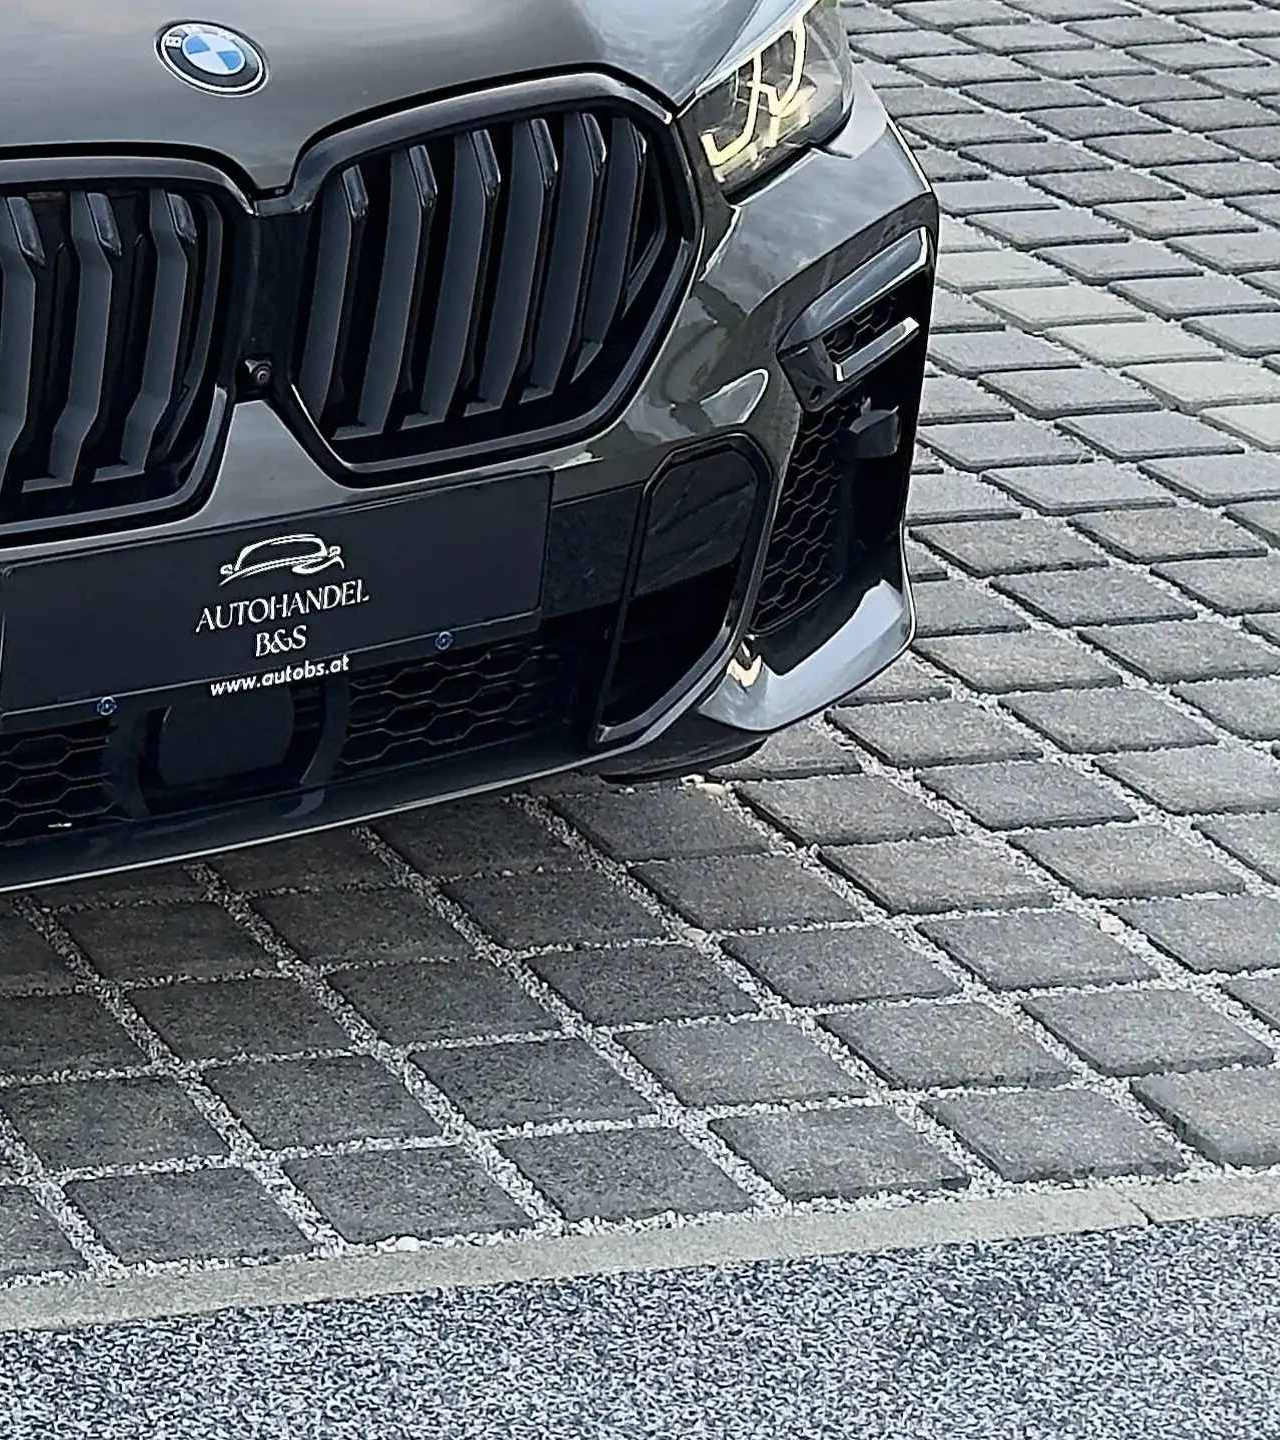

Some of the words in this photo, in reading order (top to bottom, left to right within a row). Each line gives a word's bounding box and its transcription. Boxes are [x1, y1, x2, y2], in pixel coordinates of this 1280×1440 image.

[195, 578, 370, 633] AUTOHANDEL
[255, 624, 308, 658] B&S
[210, 653, 351, 697] www.autobs.at
